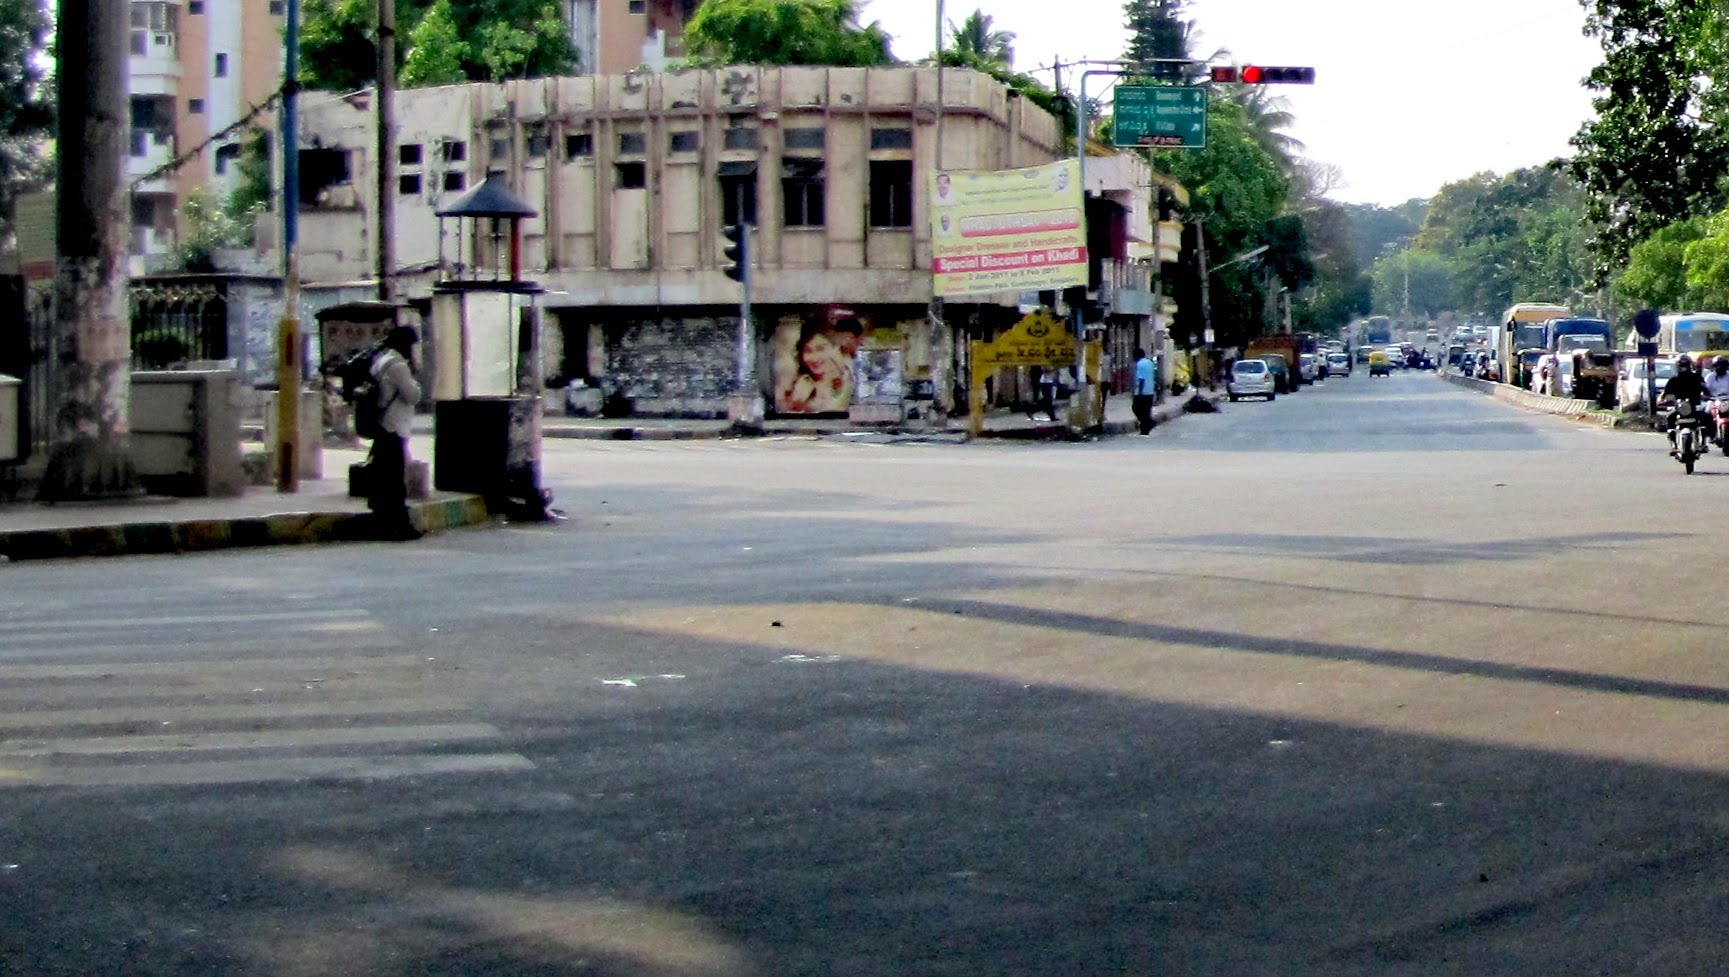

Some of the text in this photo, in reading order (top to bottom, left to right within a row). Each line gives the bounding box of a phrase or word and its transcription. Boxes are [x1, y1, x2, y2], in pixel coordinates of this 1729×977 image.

[1012, 240, 1028, 248] and
[939, 249, 1079, 272] Special Discount on Khadi
